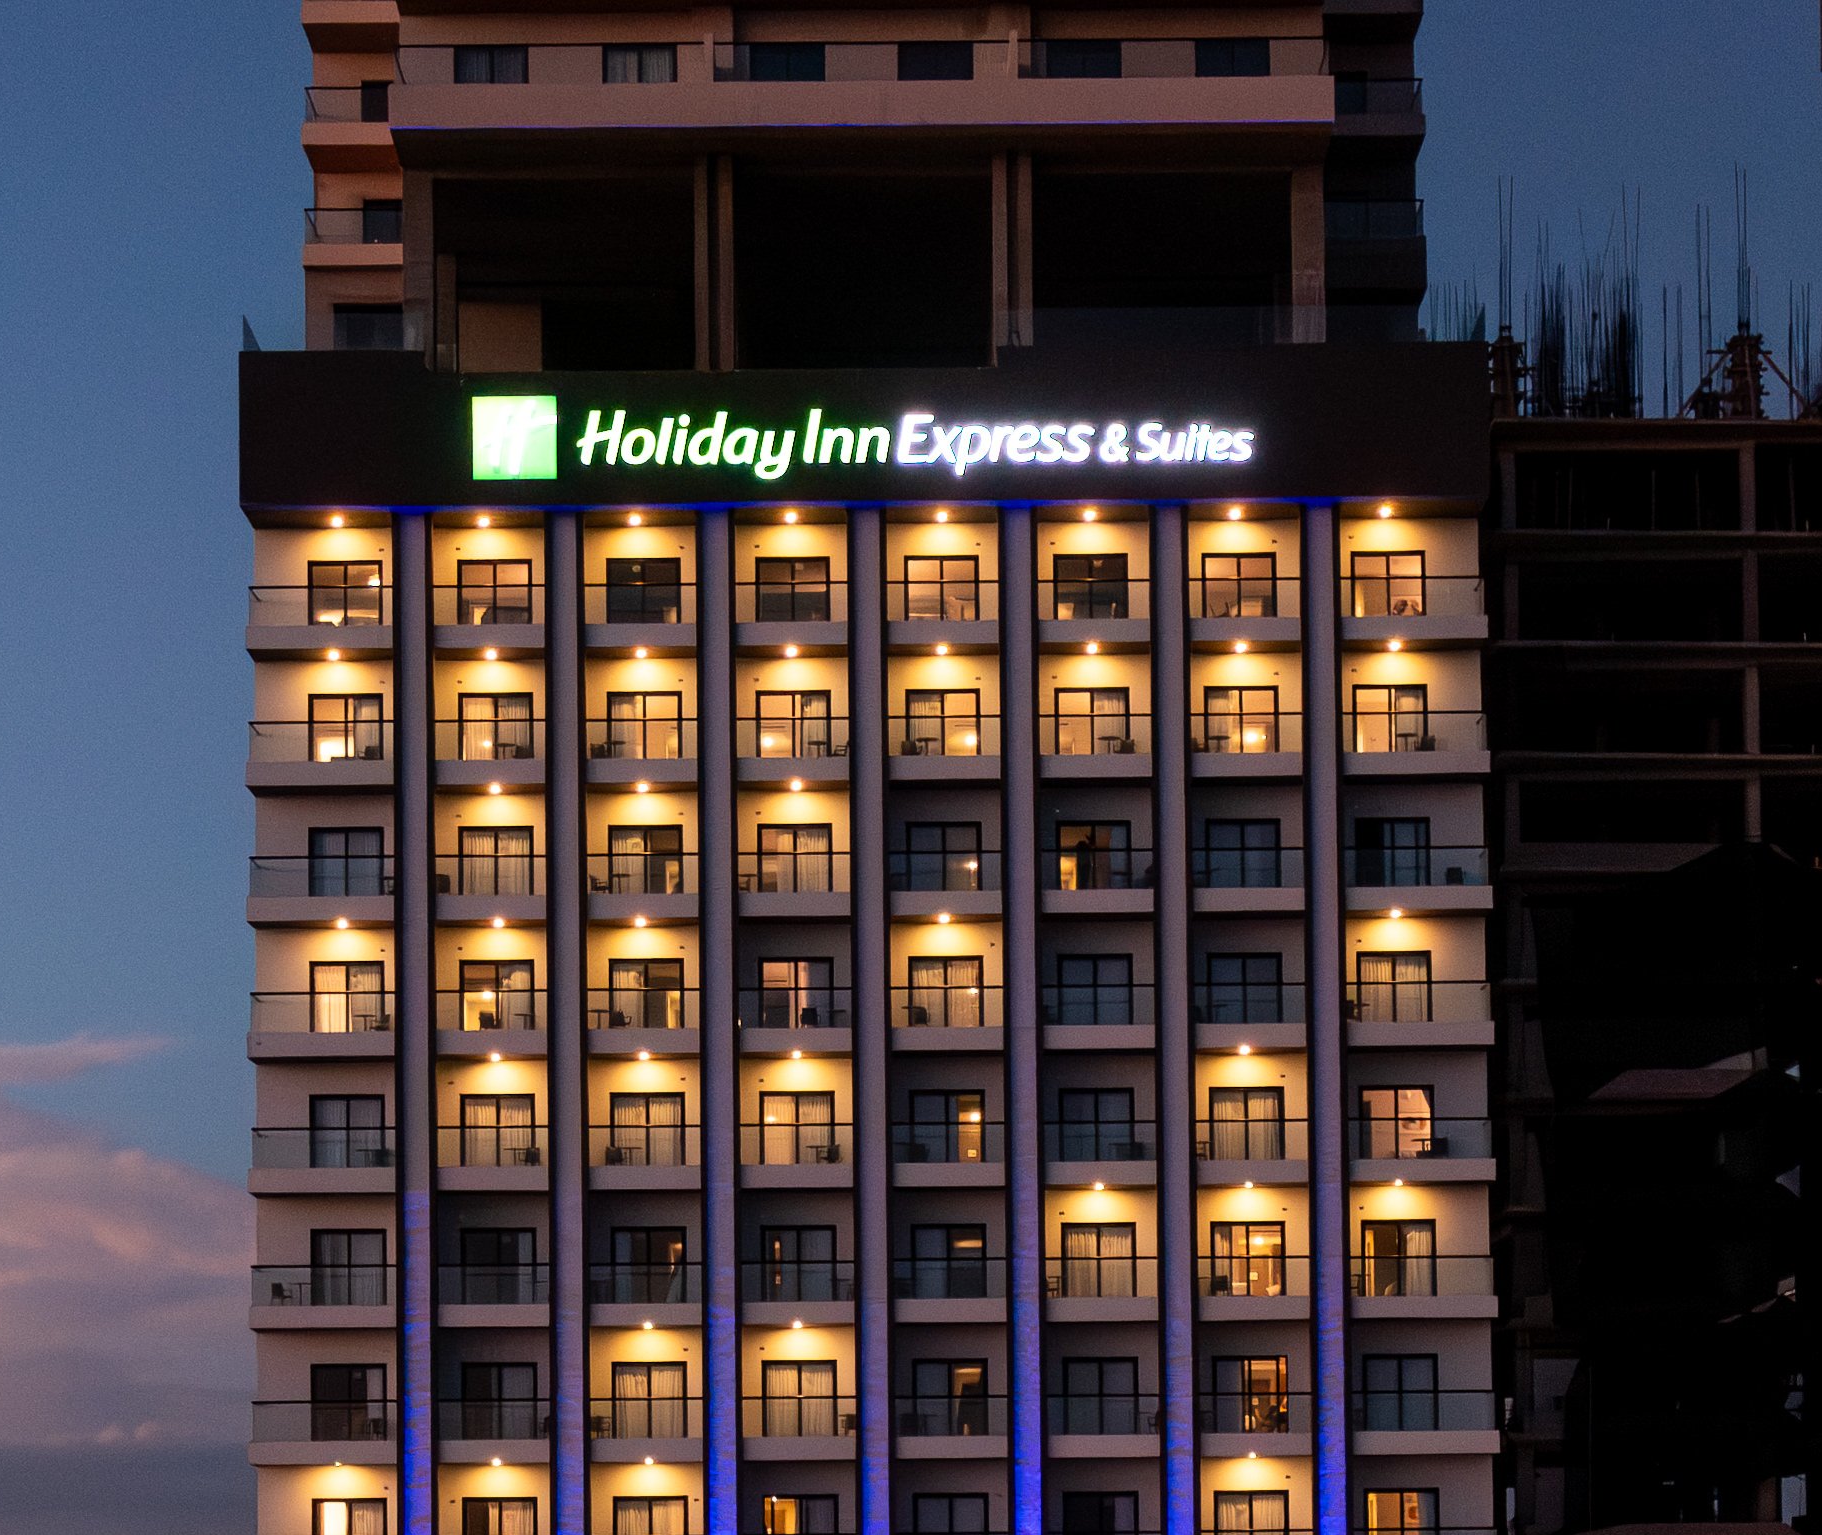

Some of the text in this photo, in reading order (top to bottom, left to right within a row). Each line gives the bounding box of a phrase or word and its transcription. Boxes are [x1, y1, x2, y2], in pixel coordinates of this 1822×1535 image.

[577, 408, 1255, 479] Holiday Inn Express & Suites
